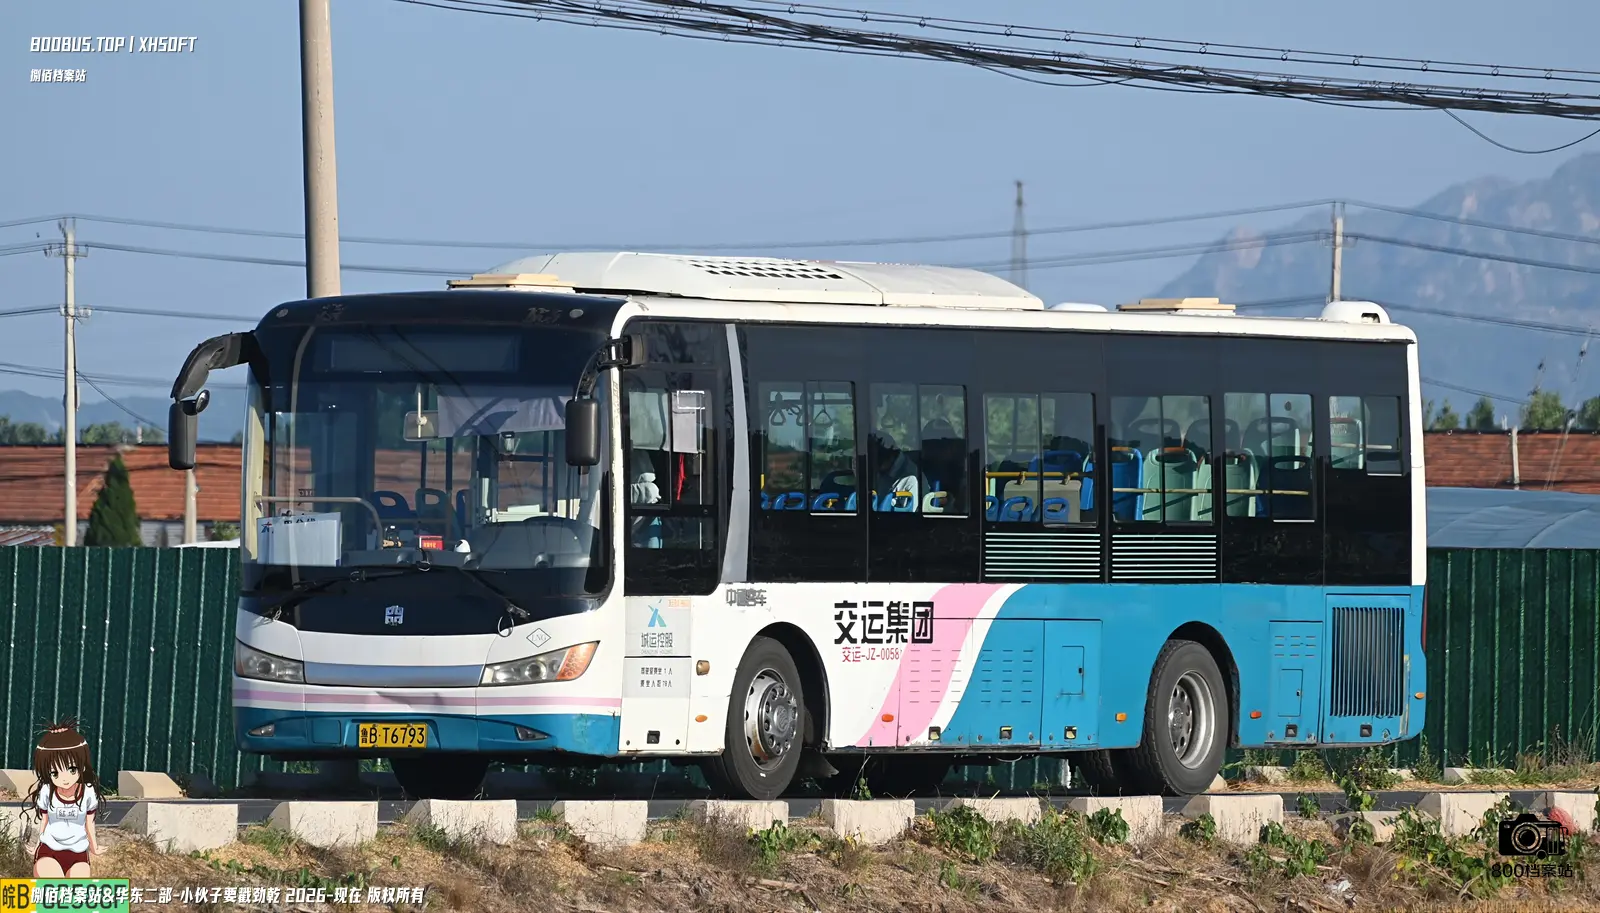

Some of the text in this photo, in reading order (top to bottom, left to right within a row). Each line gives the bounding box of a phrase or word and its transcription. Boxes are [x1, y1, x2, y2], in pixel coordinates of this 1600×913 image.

[834, 600, 934, 644] 交运集团
[641, 632, 673, 648] 城运控股
